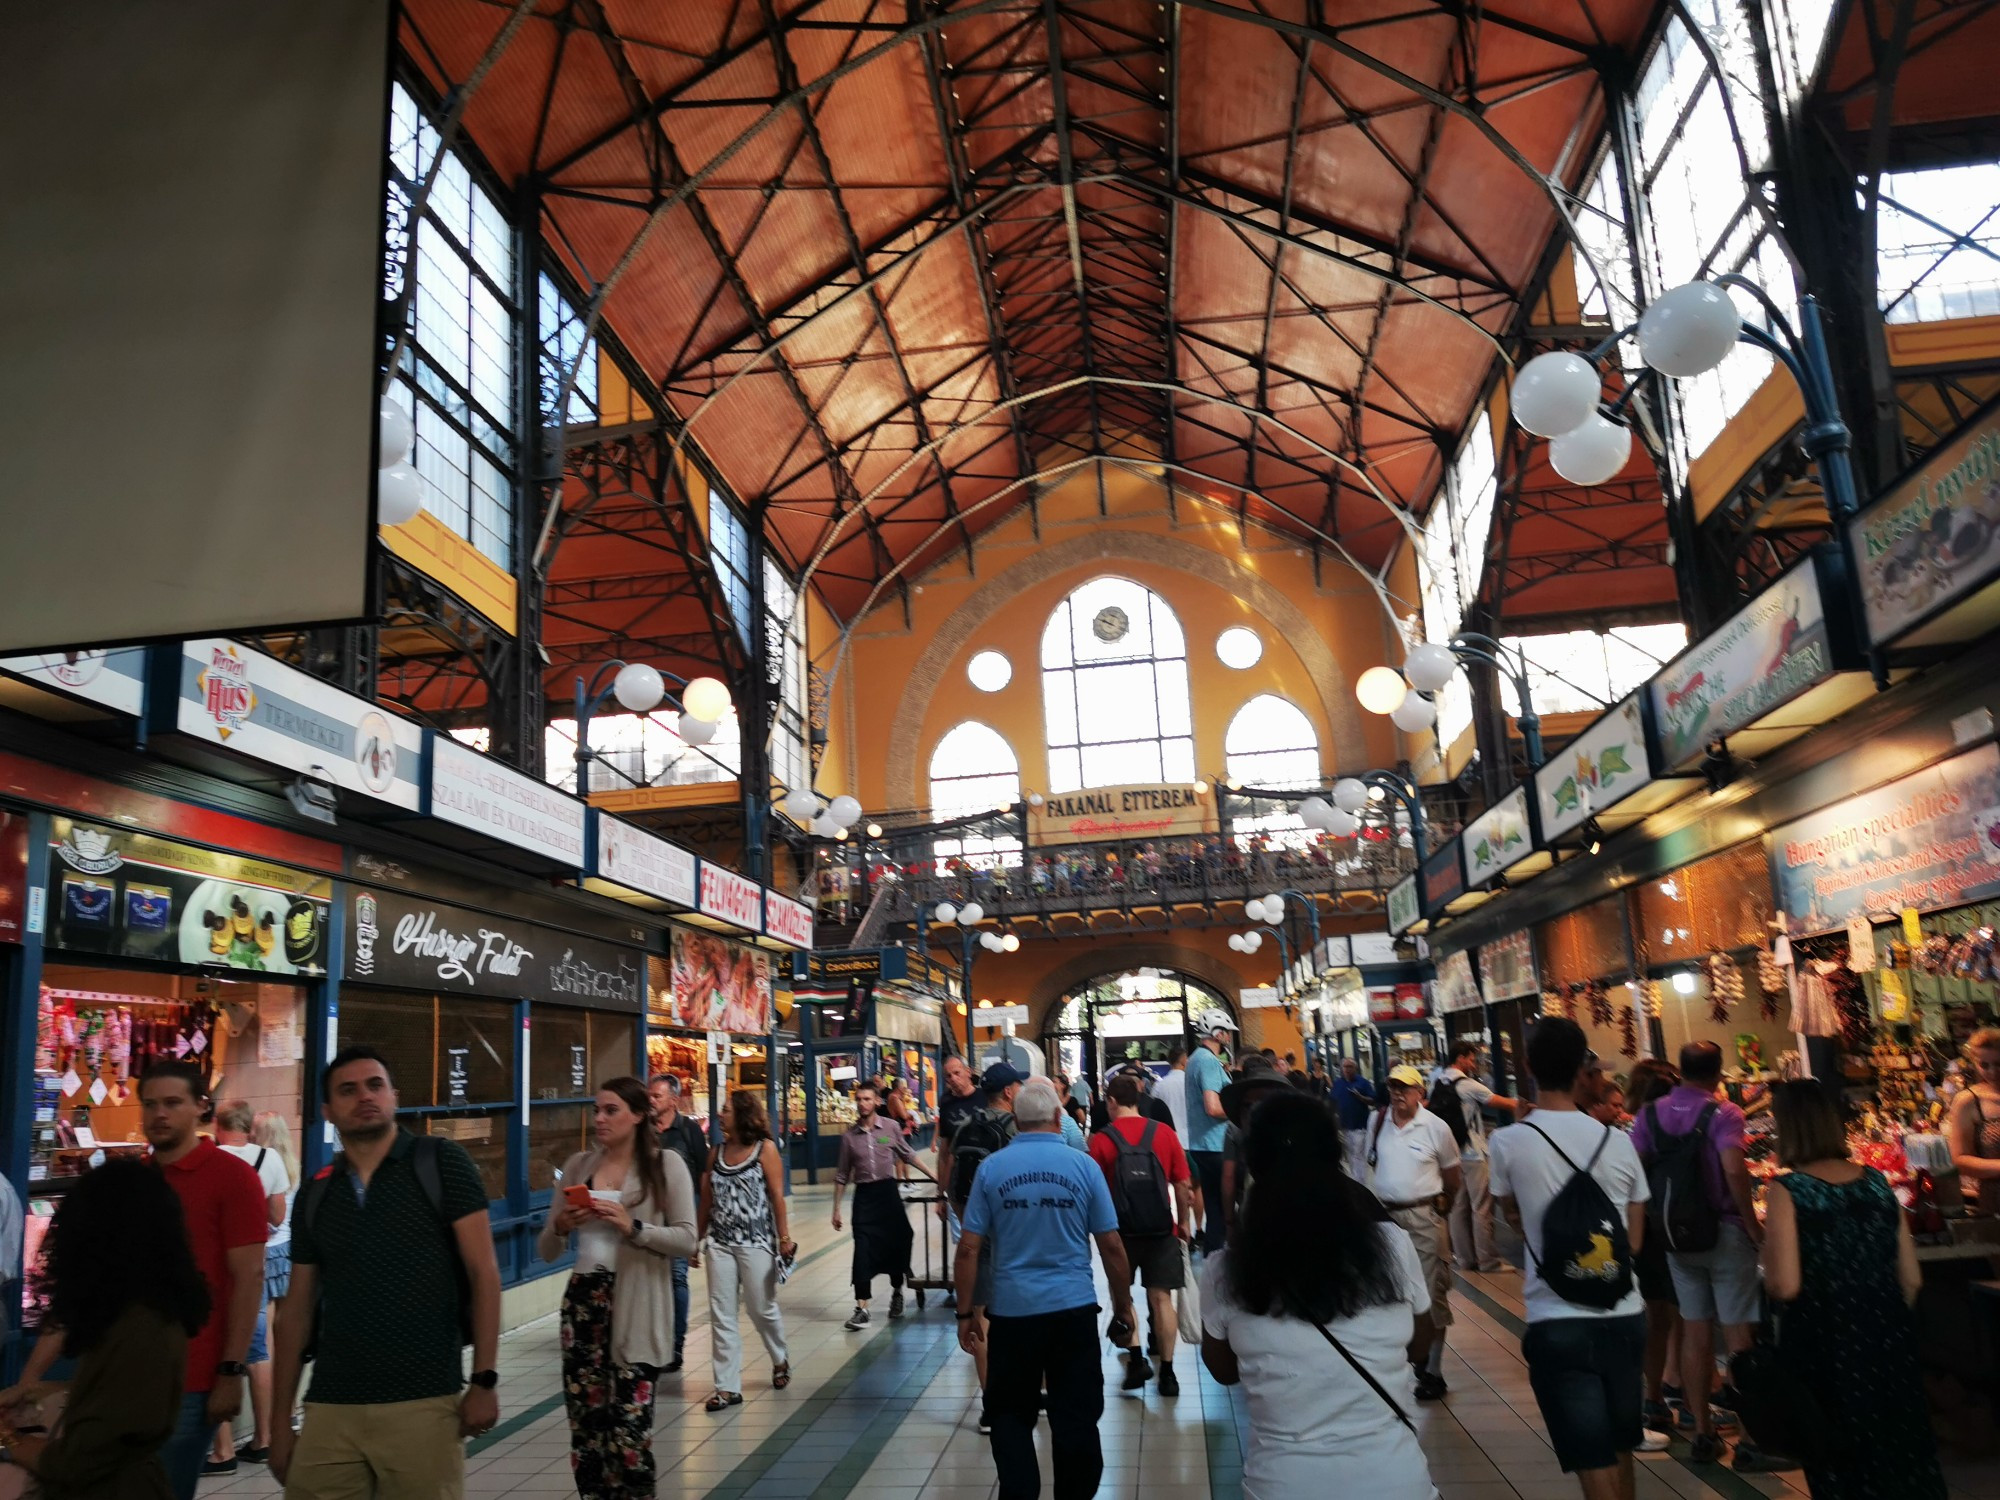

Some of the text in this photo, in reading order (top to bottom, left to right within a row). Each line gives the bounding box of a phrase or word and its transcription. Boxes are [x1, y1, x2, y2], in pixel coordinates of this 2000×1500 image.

[432, 781, 489, 821] SZALÁMI
[492, 800, 505, 827] ÉS
[1047, 788, 1197, 818] FAKANÁL ETTEREM
[1784, 785, 1961, 868] Hungarian specialities
[393, 911, 534, 986] Huszár Falat
[1003, 1199, 1029, 1209] CIVIL
